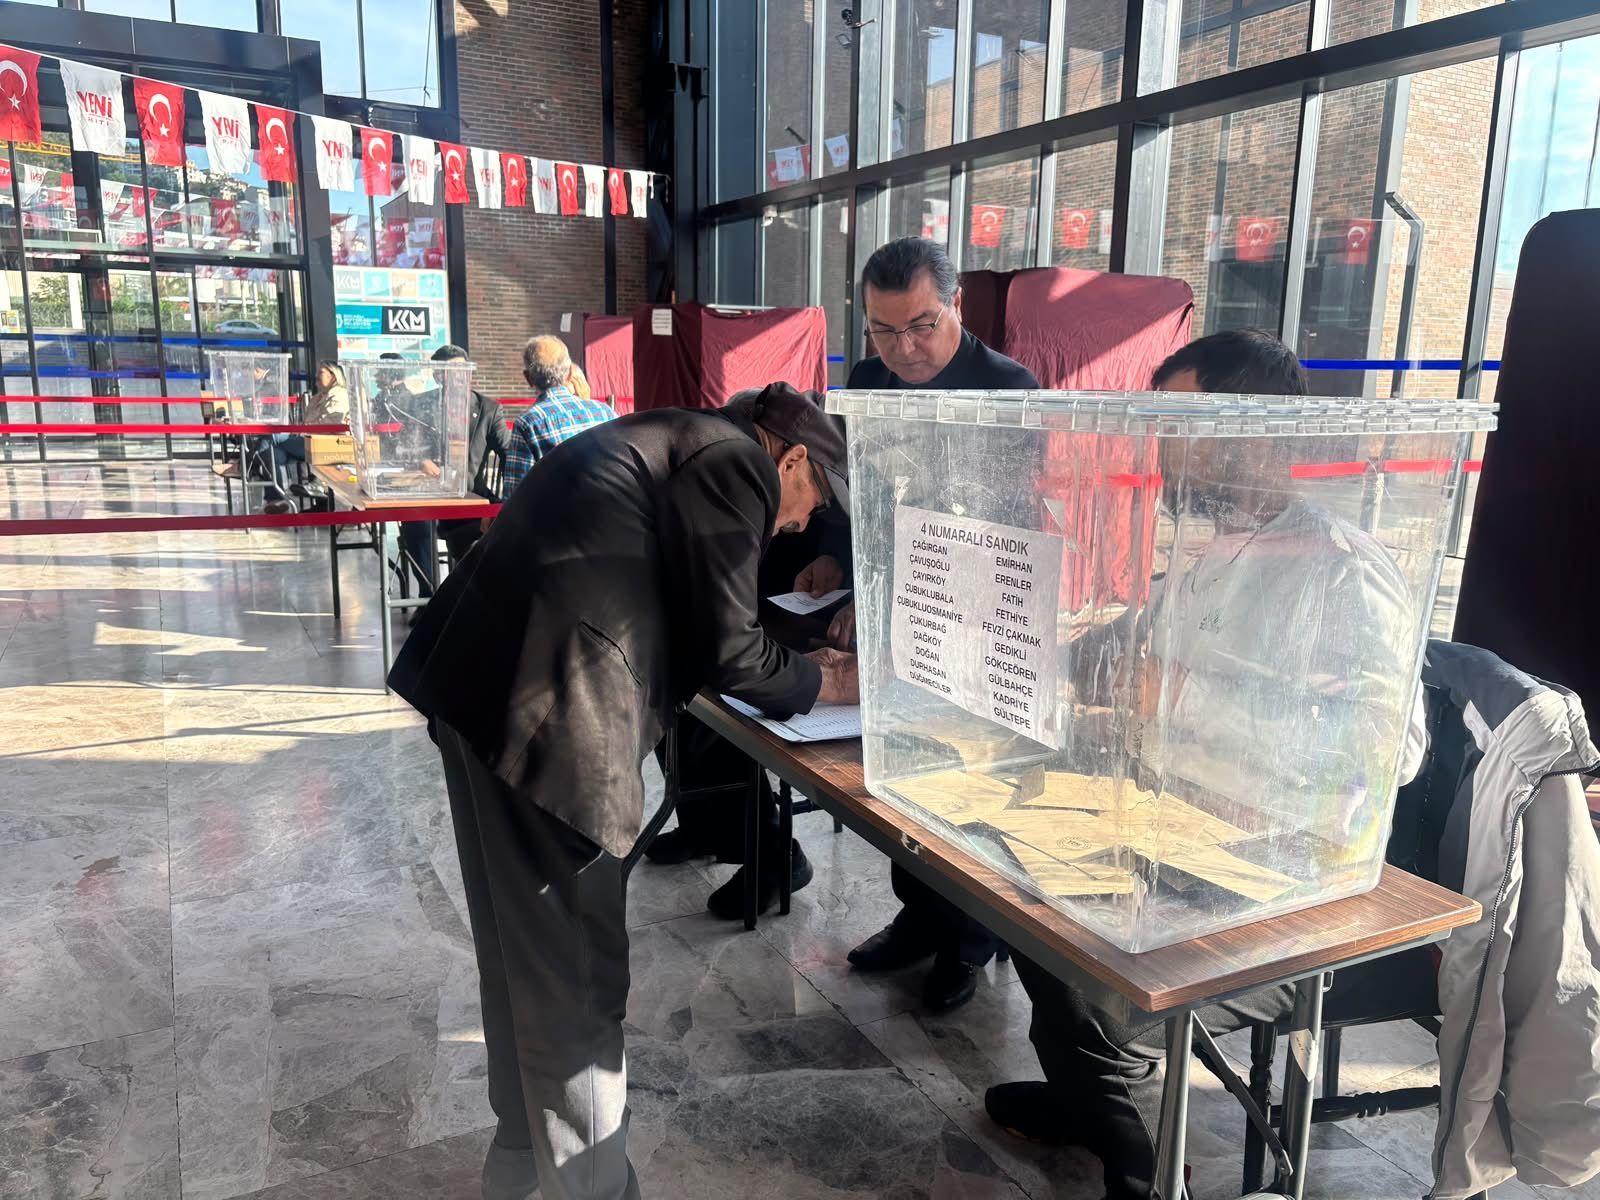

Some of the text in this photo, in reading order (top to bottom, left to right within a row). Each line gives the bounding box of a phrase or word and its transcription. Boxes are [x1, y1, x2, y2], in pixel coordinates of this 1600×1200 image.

[387, 309, 426, 332] KKM
[912, 540, 948, 555] ÇAĞIRGAN
[920, 522, 1029, 557] 4 NUMARALI SANDIK
[909, 554, 950, 571] ÇAVUŞOĞLU
[995, 556, 1033, 574] EMİRHAN
[912, 570, 946, 586] ÇAYIRKÖY
[995, 573, 1032, 591] ERENLER
[904, 583, 954, 605] ÇUBUKLUBALA
[1001, 592, 1024, 607] FATİH
[896, 595, 963, 624] ÇUBUKLUOSMANİYE
[995, 608, 1029, 627] FETHİYE
[909, 614, 947, 634] ÇUKURBAĞ
[913, 631, 942, 647] DAĞKÖY
[982, 621, 1041, 648] FEVZİ ÇAKMAK
[915, 646, 940, 662] DOĞAN
[994, 642, 1027, 661] GEDİKLİ
[910, 659, 947, 680] DURHASAN
[984, 655, 1037, 682] GÖKÇEÖREN
[988, 673, 1033, 698] GÜLBAHÇE
[993, 690, 1030, 713] KADRİYE
[993, 706, 1031, 730] GÜLTEPE
